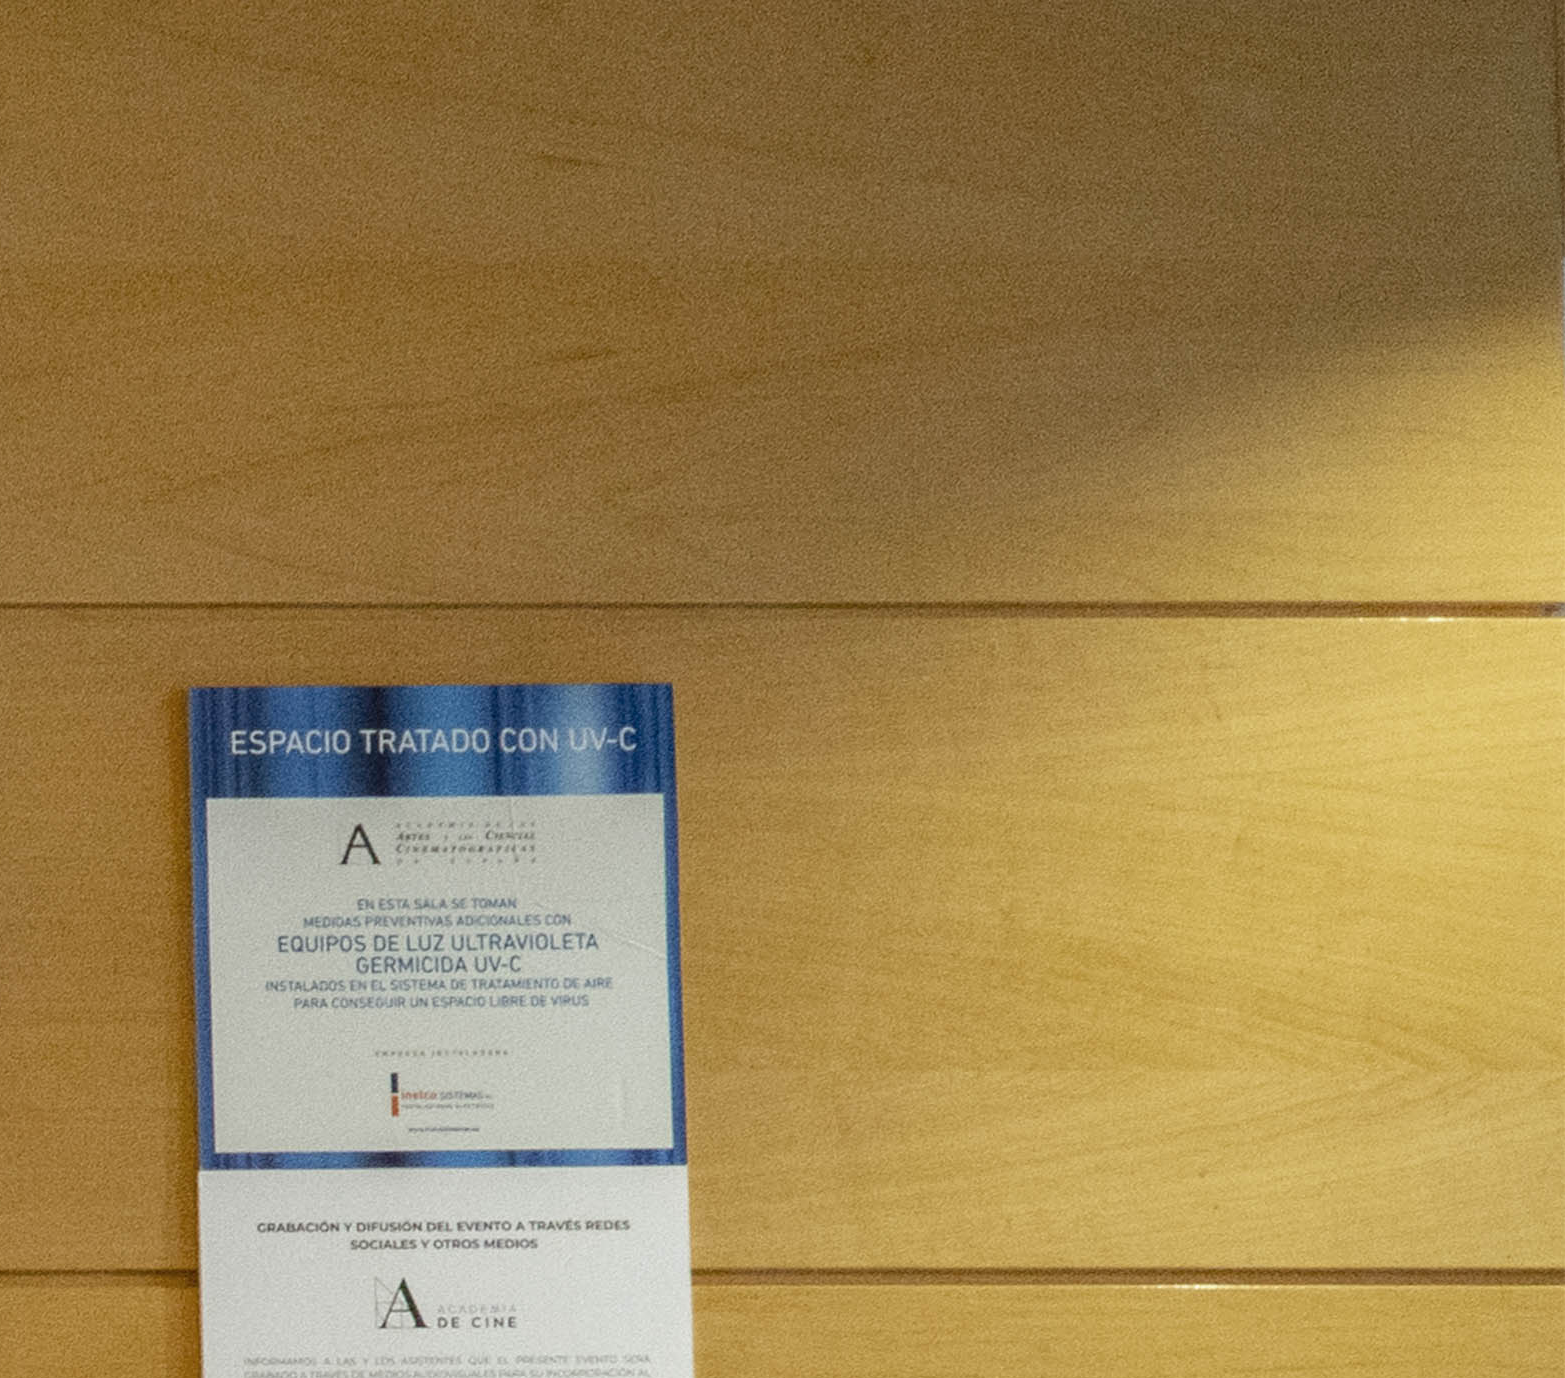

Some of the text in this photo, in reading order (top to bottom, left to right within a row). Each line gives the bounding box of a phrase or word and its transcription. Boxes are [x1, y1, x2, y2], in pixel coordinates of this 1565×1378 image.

[231, 726, 637, 755] ESPACIO TRATADO CON UV-C
[340, 823, 381, 865] A
[356, 897, 516, 910] EN ESTA SALA SE TOMAN
[302, 913, 571, 927] MEDIDAS PREVENTIVAS ADICIONALES CON
[276, 932, 599, 952] EQUIPOS DE LUZ ULTRAVIOLETA
[355, 955, 521, 973] GERMICIDA UV-C
[264, 977, 611, 991] INSTALADOS EN EL SISTEMA DE TRATAMIENTO DE AIRE
[292, 994, 588, 1008] PARA CONSEGUIR UN ESPACIO LIBRE DE VIRUS
[343, 1221, 352, 1231] Y
[425, 1221, 450, 1231] DEL
[455, 1220, 511, 1230] EVENTO
[515, 1221, 524, 1230] A
[584, 1219, 629, 1230] REDES
[349, 1238, 537, 1249] SOCIALES Y OTROS MEDIOS
[379, 1277, 428, 1329] A
[436, 1316, 516, 1328] DE CINE
